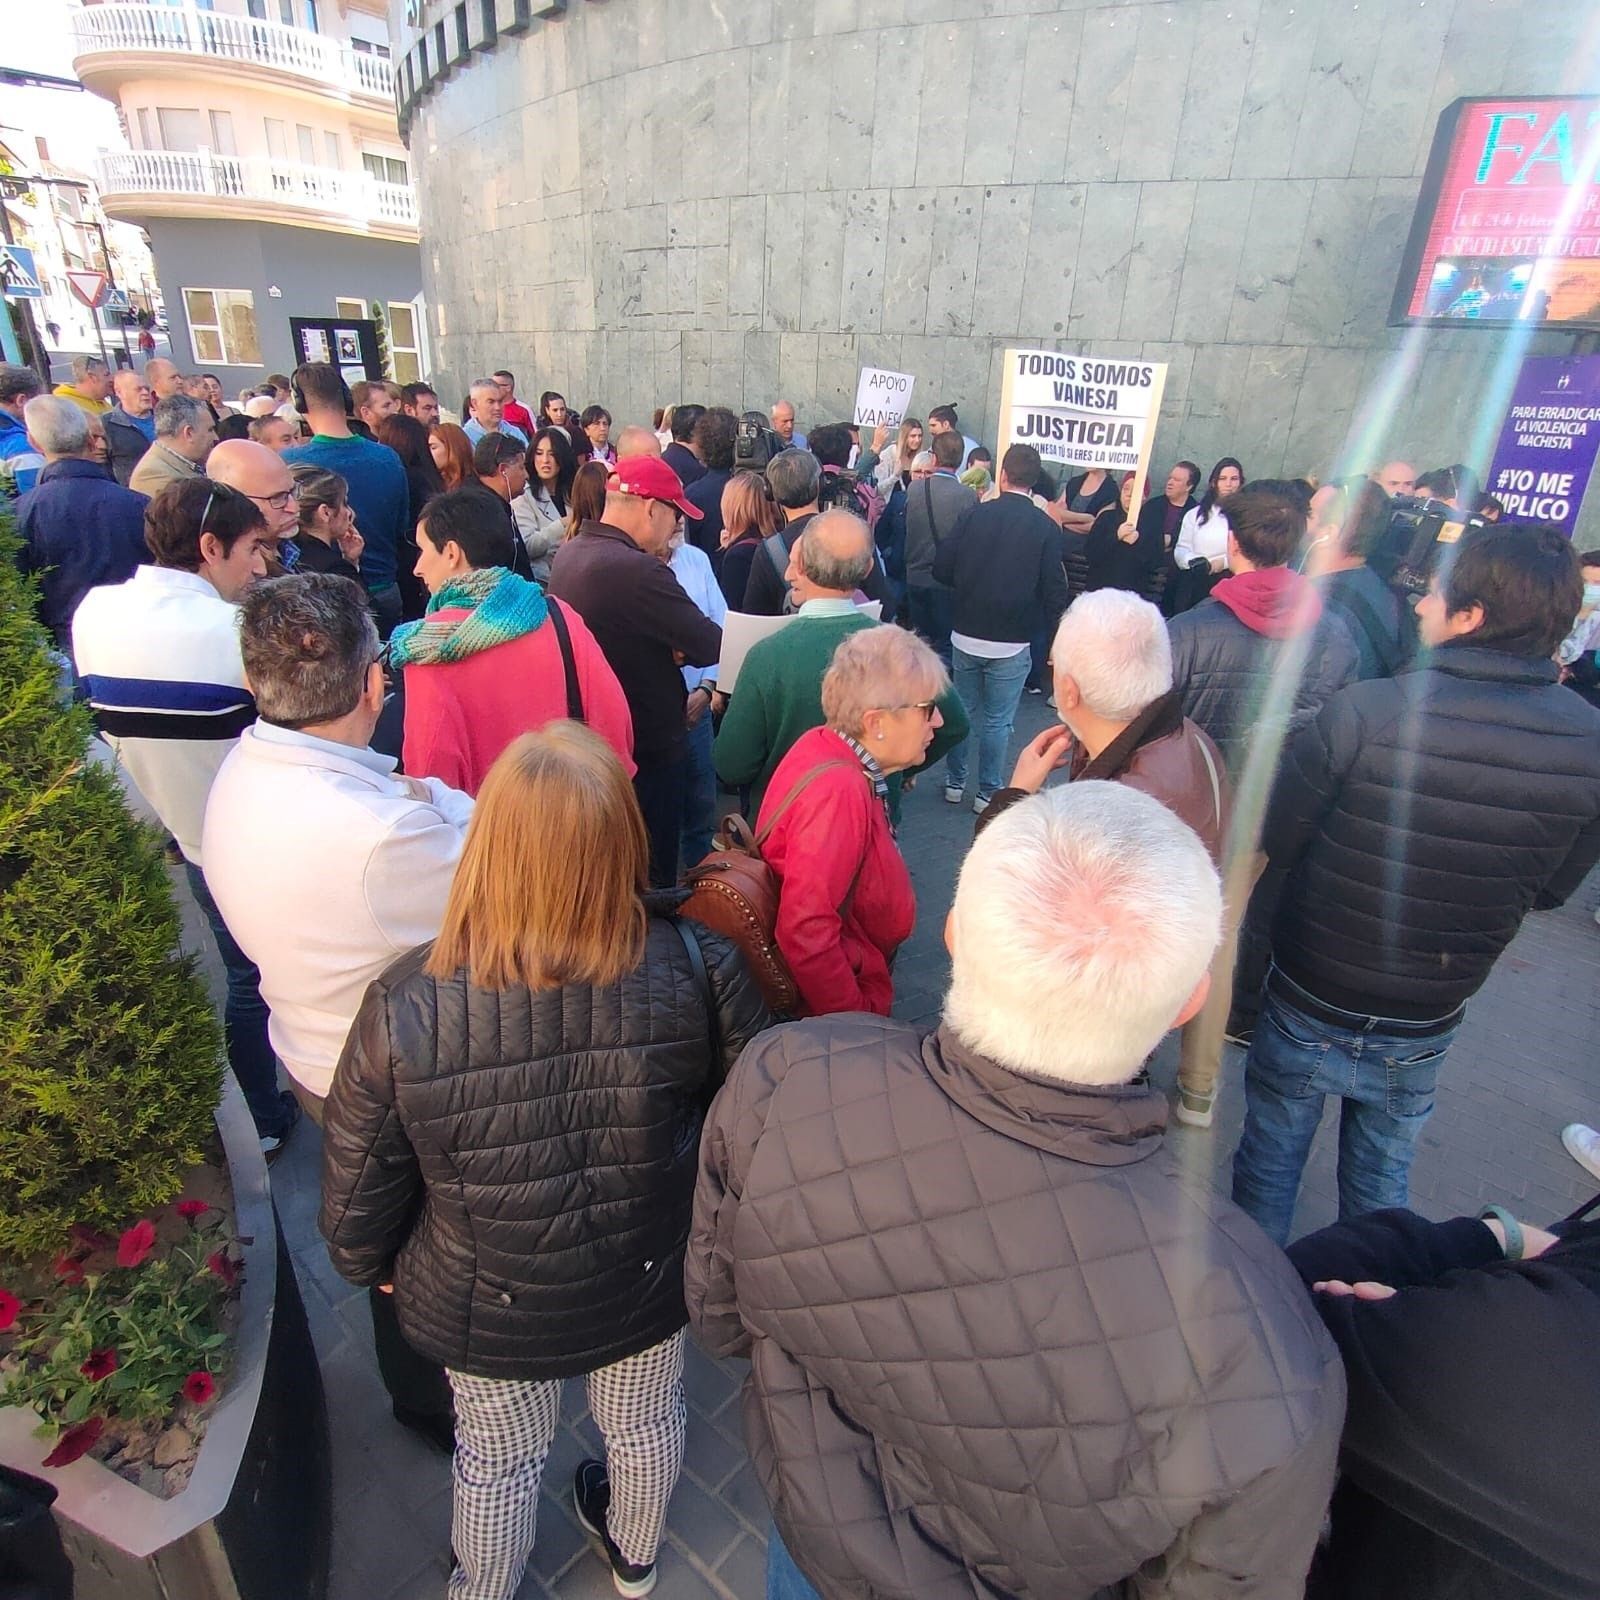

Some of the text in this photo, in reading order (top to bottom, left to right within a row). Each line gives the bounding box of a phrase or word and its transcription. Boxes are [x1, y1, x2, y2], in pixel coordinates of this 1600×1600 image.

[1018, 354, 1153, 388] TODOS SOMOS
[869, 373, 907, 393] APOYO
[885, 395, 891, 405] A
[1053, 380, 1118, 411] VANESA
[1511, 406, 1537, 419] PARA
[1016, 413, 1135, 448] JUSTICIA
[1514, 420, 1588, 436] LA VIOLENCIA
[1516, 434, 1573, 450] MACHISTA
[1066, 447, 1073, 459] SI
[1074, 448, 1093, 462] ERES
[1095, 450, 1106, 463] LA
[1496, 469, 1575, 496] #YO ME
